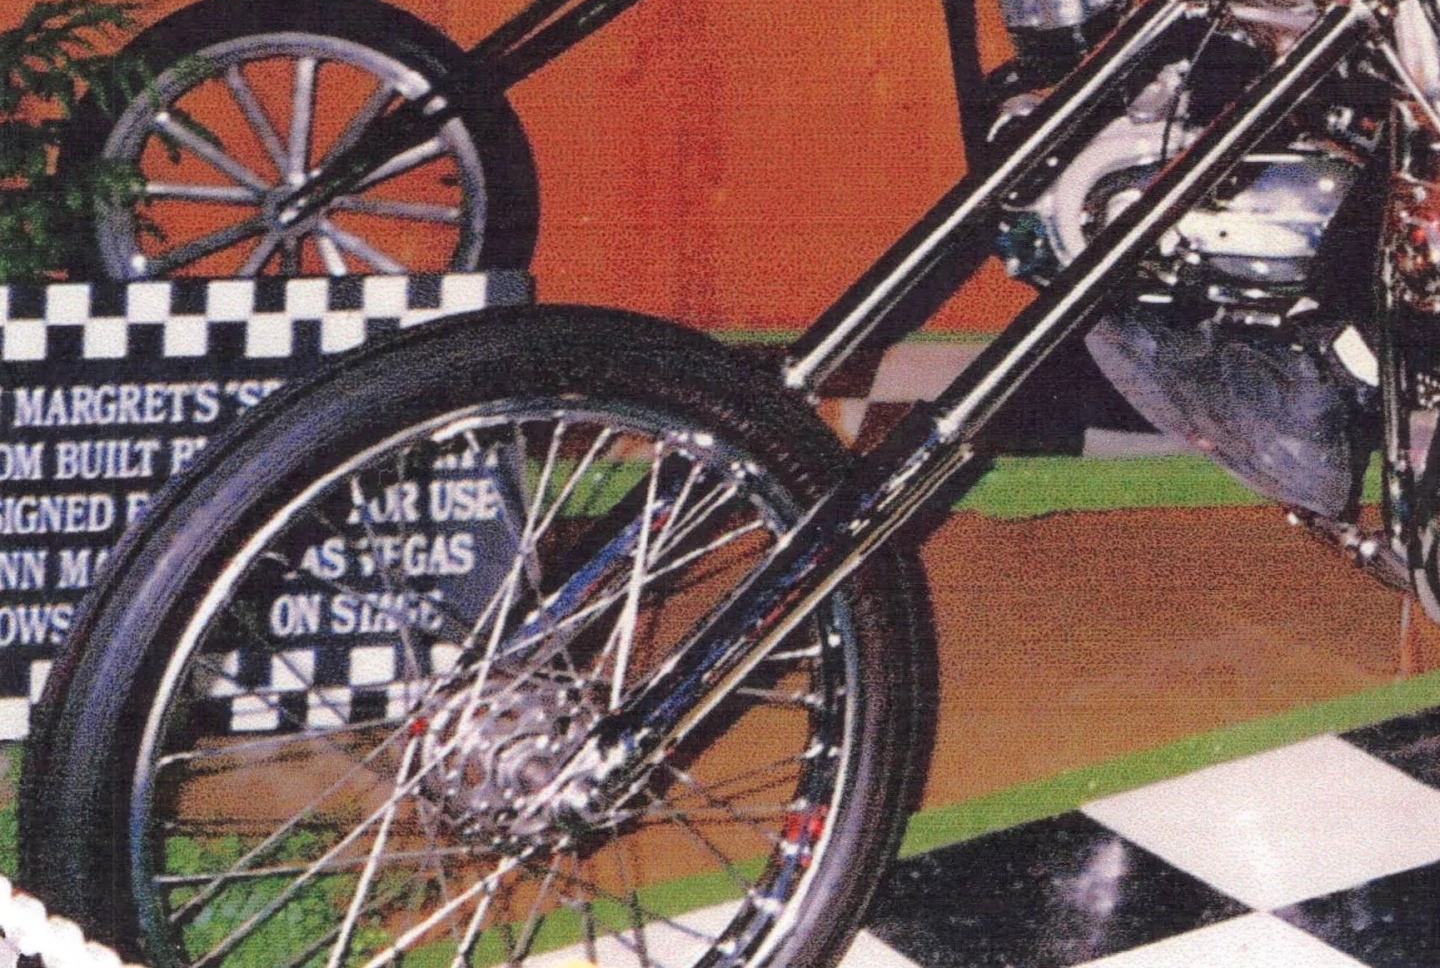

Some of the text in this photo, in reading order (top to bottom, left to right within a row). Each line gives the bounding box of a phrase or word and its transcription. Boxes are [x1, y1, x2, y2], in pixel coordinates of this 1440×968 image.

[53, 438, 161, 480] BUILT
[429, 479, 501, 522] USE
[270, 594, 322, 637] ON
